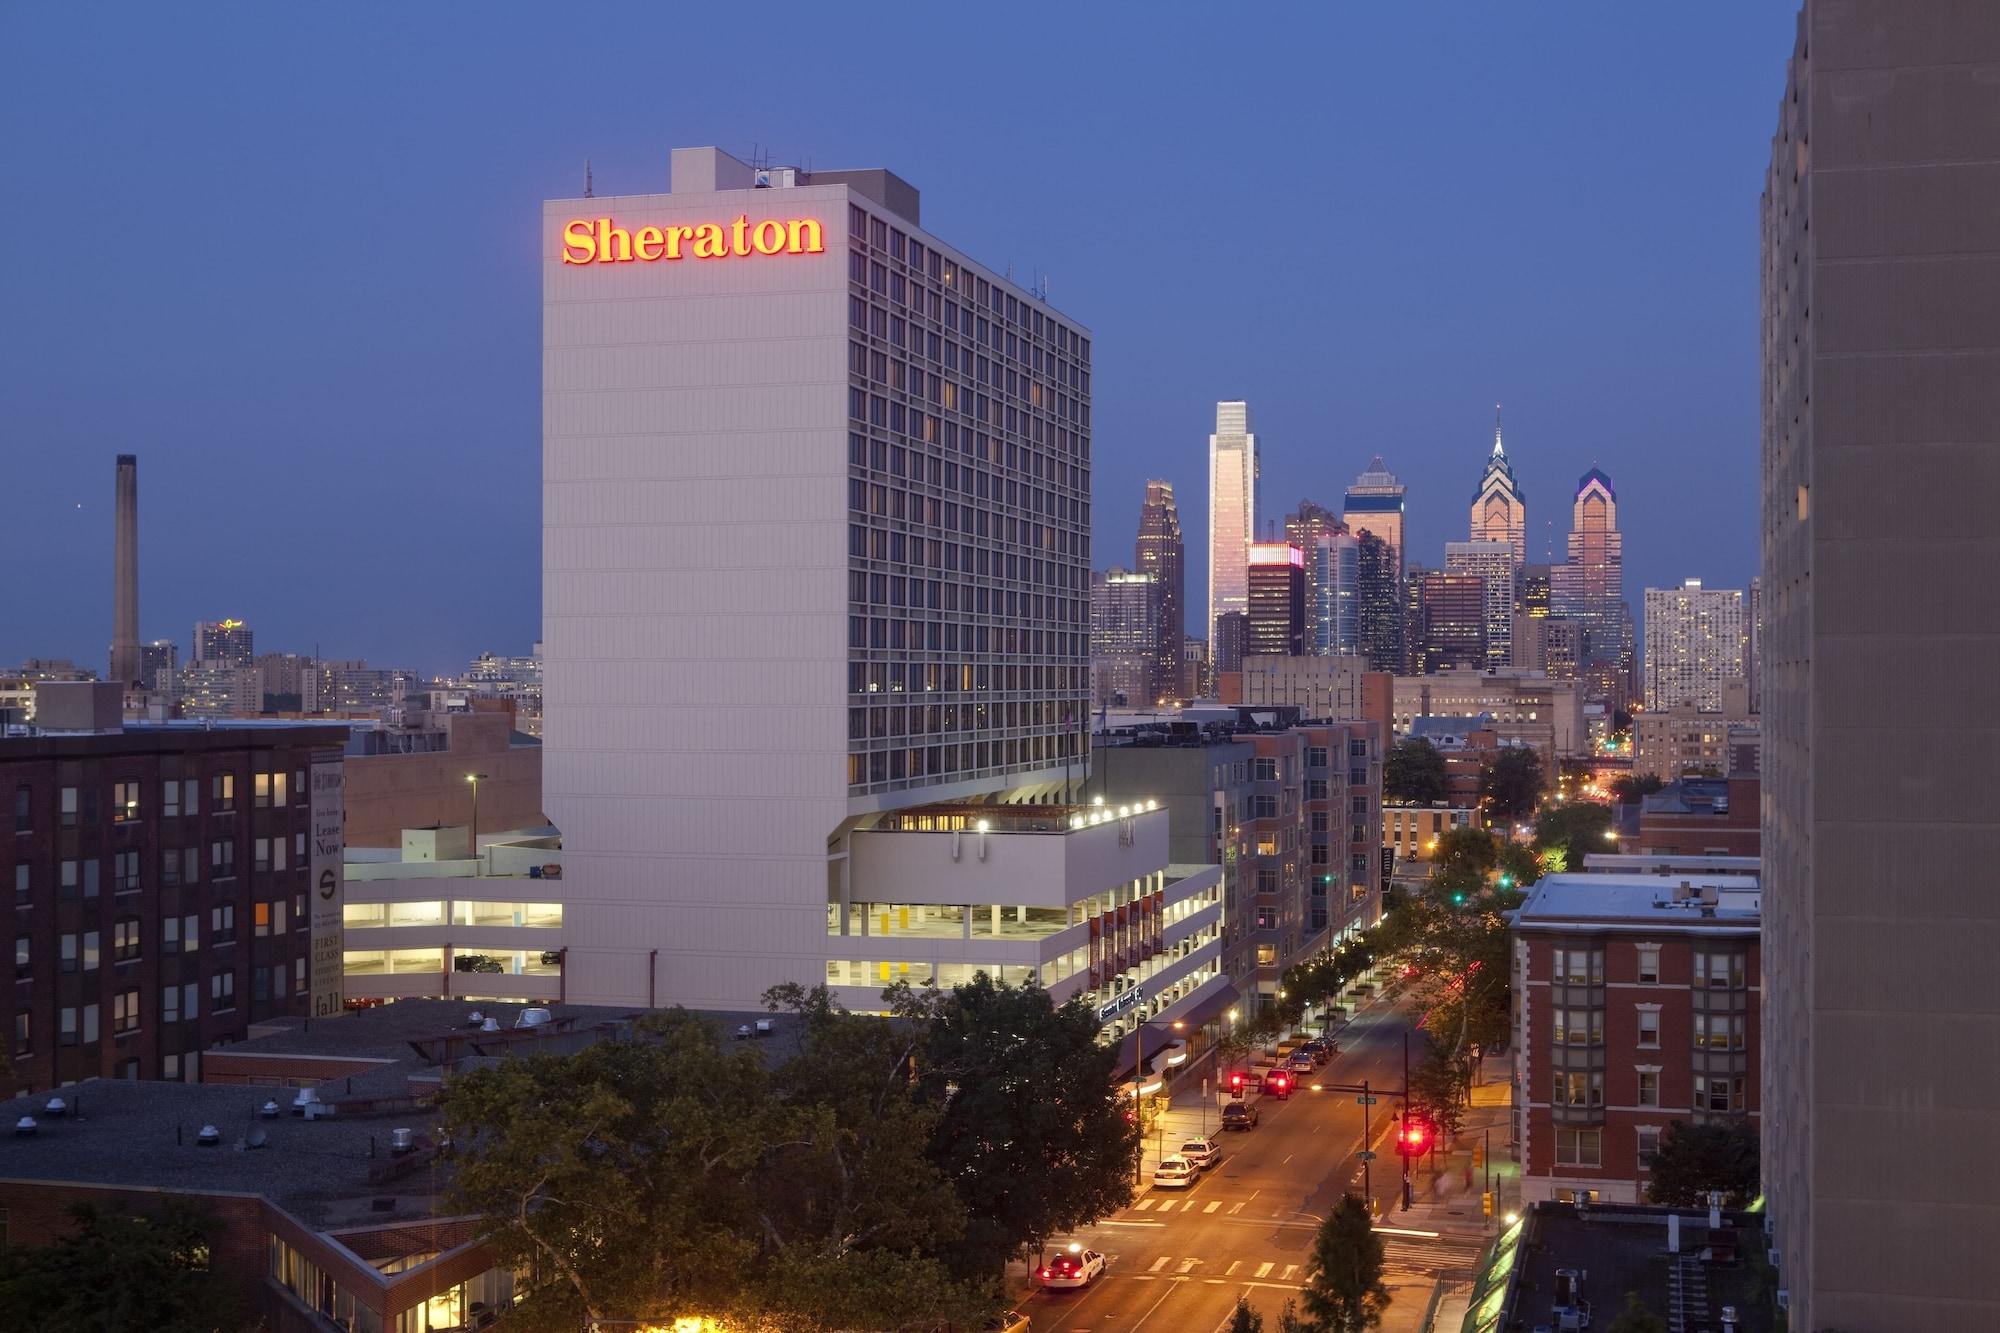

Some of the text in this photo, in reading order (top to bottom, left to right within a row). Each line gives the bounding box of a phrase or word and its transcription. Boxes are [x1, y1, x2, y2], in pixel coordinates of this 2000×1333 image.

[562, 214, 824, 264] Sheraton
[316, 823, 340, 837] Lease
[316, 839, 340, 857] Now
[1381, 849, 1391, 883] domus
[315, 935, 338, 950] FIRST
[315, 950, 340, 962] CLASS
[315, 992, 340, 1017] fall
